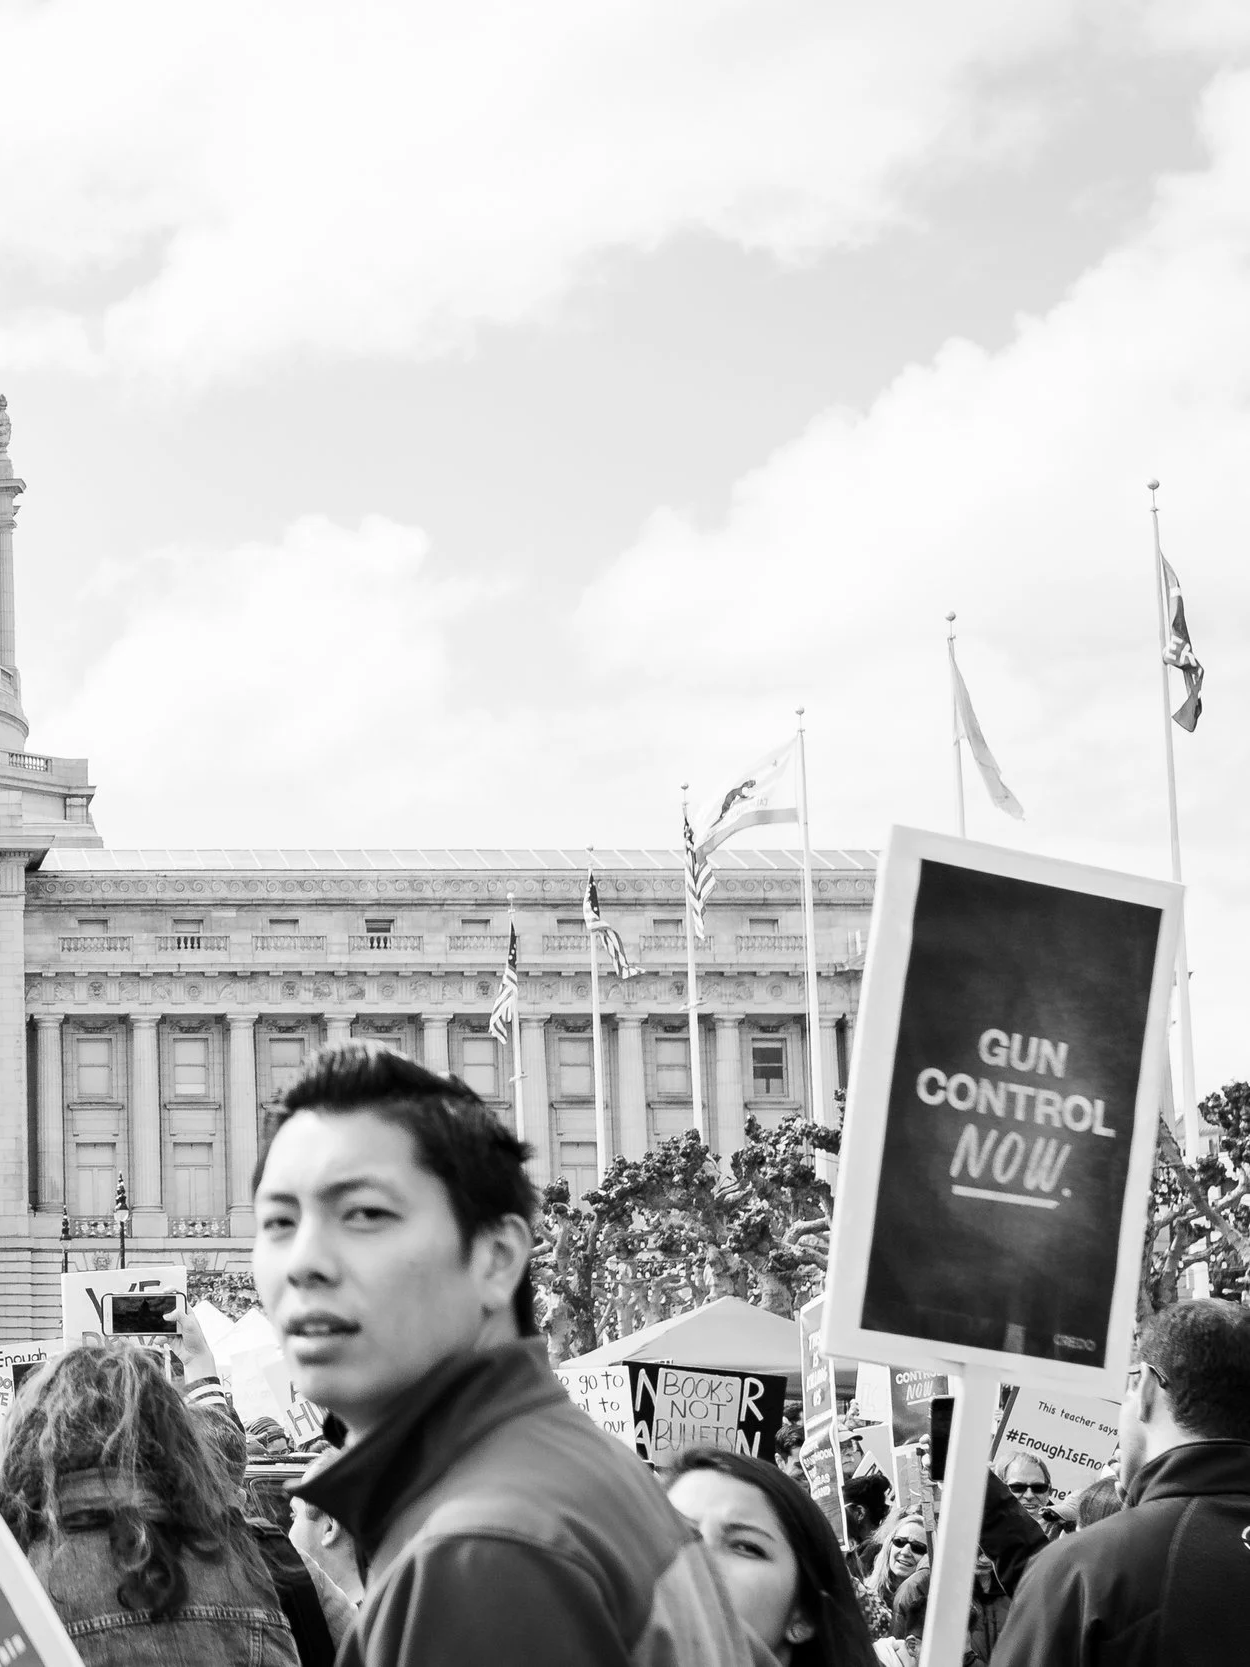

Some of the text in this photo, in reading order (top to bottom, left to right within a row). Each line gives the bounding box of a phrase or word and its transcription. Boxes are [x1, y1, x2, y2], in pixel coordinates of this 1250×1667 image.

[978, 1028, 1069, 1078] GUN
[916, 1067, 1117, 1138] CONTROL
[950, 1123, 1073, 1198] NOW.
[578, 1374, 598, 1395] go
[600, 1371, 625, 1390] to
[663, 1371, 734, 1403] BOOKS
[905, 1380, 936, 1402] NOW.
[598, 1397, 621, 1413] to
[670, 1399, 728, 1422] NOT
[1038, 1400, 1119, 1437] This teacher says
[603, 1420, 631, 1434] our
[1006, 1428, 1106, 1471] #EnoughIsEno
